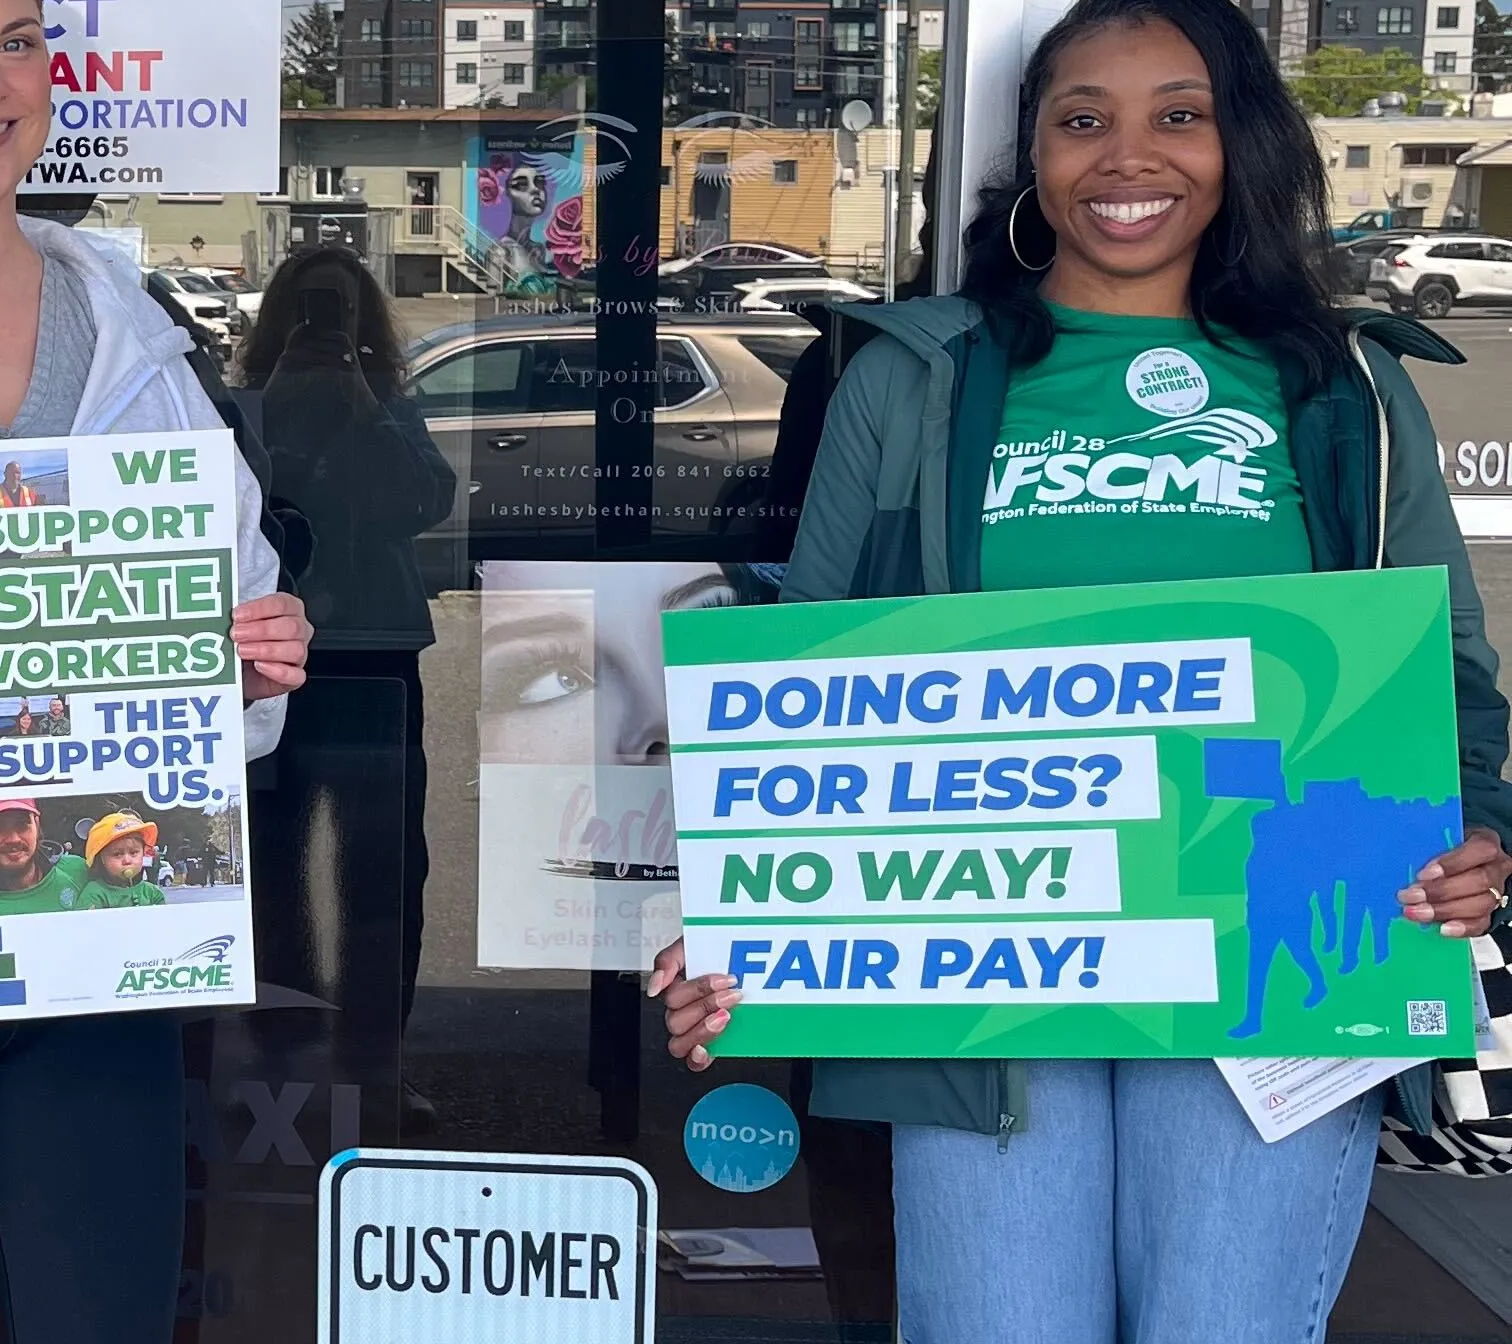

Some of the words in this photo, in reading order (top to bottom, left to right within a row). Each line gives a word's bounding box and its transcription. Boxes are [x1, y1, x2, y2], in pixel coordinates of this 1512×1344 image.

[50, 51, 163, 92] ANT
[40, 136, 129, 158] -6665
[592, 297, 657, 316] Brows
[1136, 376, 1205, 398] CONTRACT!
[1140, 365, 1190, 384] STRONG
[992, 429, 1066, 458] ouncil
[1070, 435, 1106, 451] 28
[112, 448, 198, 485] WE
[521, 464, 620, 479] Text/Call
[631, 465, 666, 478] 206
[677, 465, 712, 478] 841
[723, 465, 772, 478] 6662
[982, 507, 1025, 525] ngton
[1028, 500, 1117, 517] Federation
[1119, 500, 1140, 515] of
[1141, 501, 1187, 515] State
[1190, 501, 1271, 523] Employees
[707, 666, 963, 732] DOING
[979, 657, 1227, 722] MORE
[95, 696, 221, 735] THEY
[147, 770, 224, 804] US.
[713, 761, 870, 819] FOR
[886, 752, 1124, 815] LESS?
[656, 868, 679, 877] Beth
[719, 850, 834, 904] NO
[855, 845, 1074, 902] WAY!
[554, 899, 607, 919] Skin
[524, 927, 617, 951] Eyelash
[726, 939, 899, 990] FAIR
[918, 935, 1107, 991] PAY!
[115, 964, 233, 993] AFSCME
[353, 1224, 621, 1301] CUSTOMER
